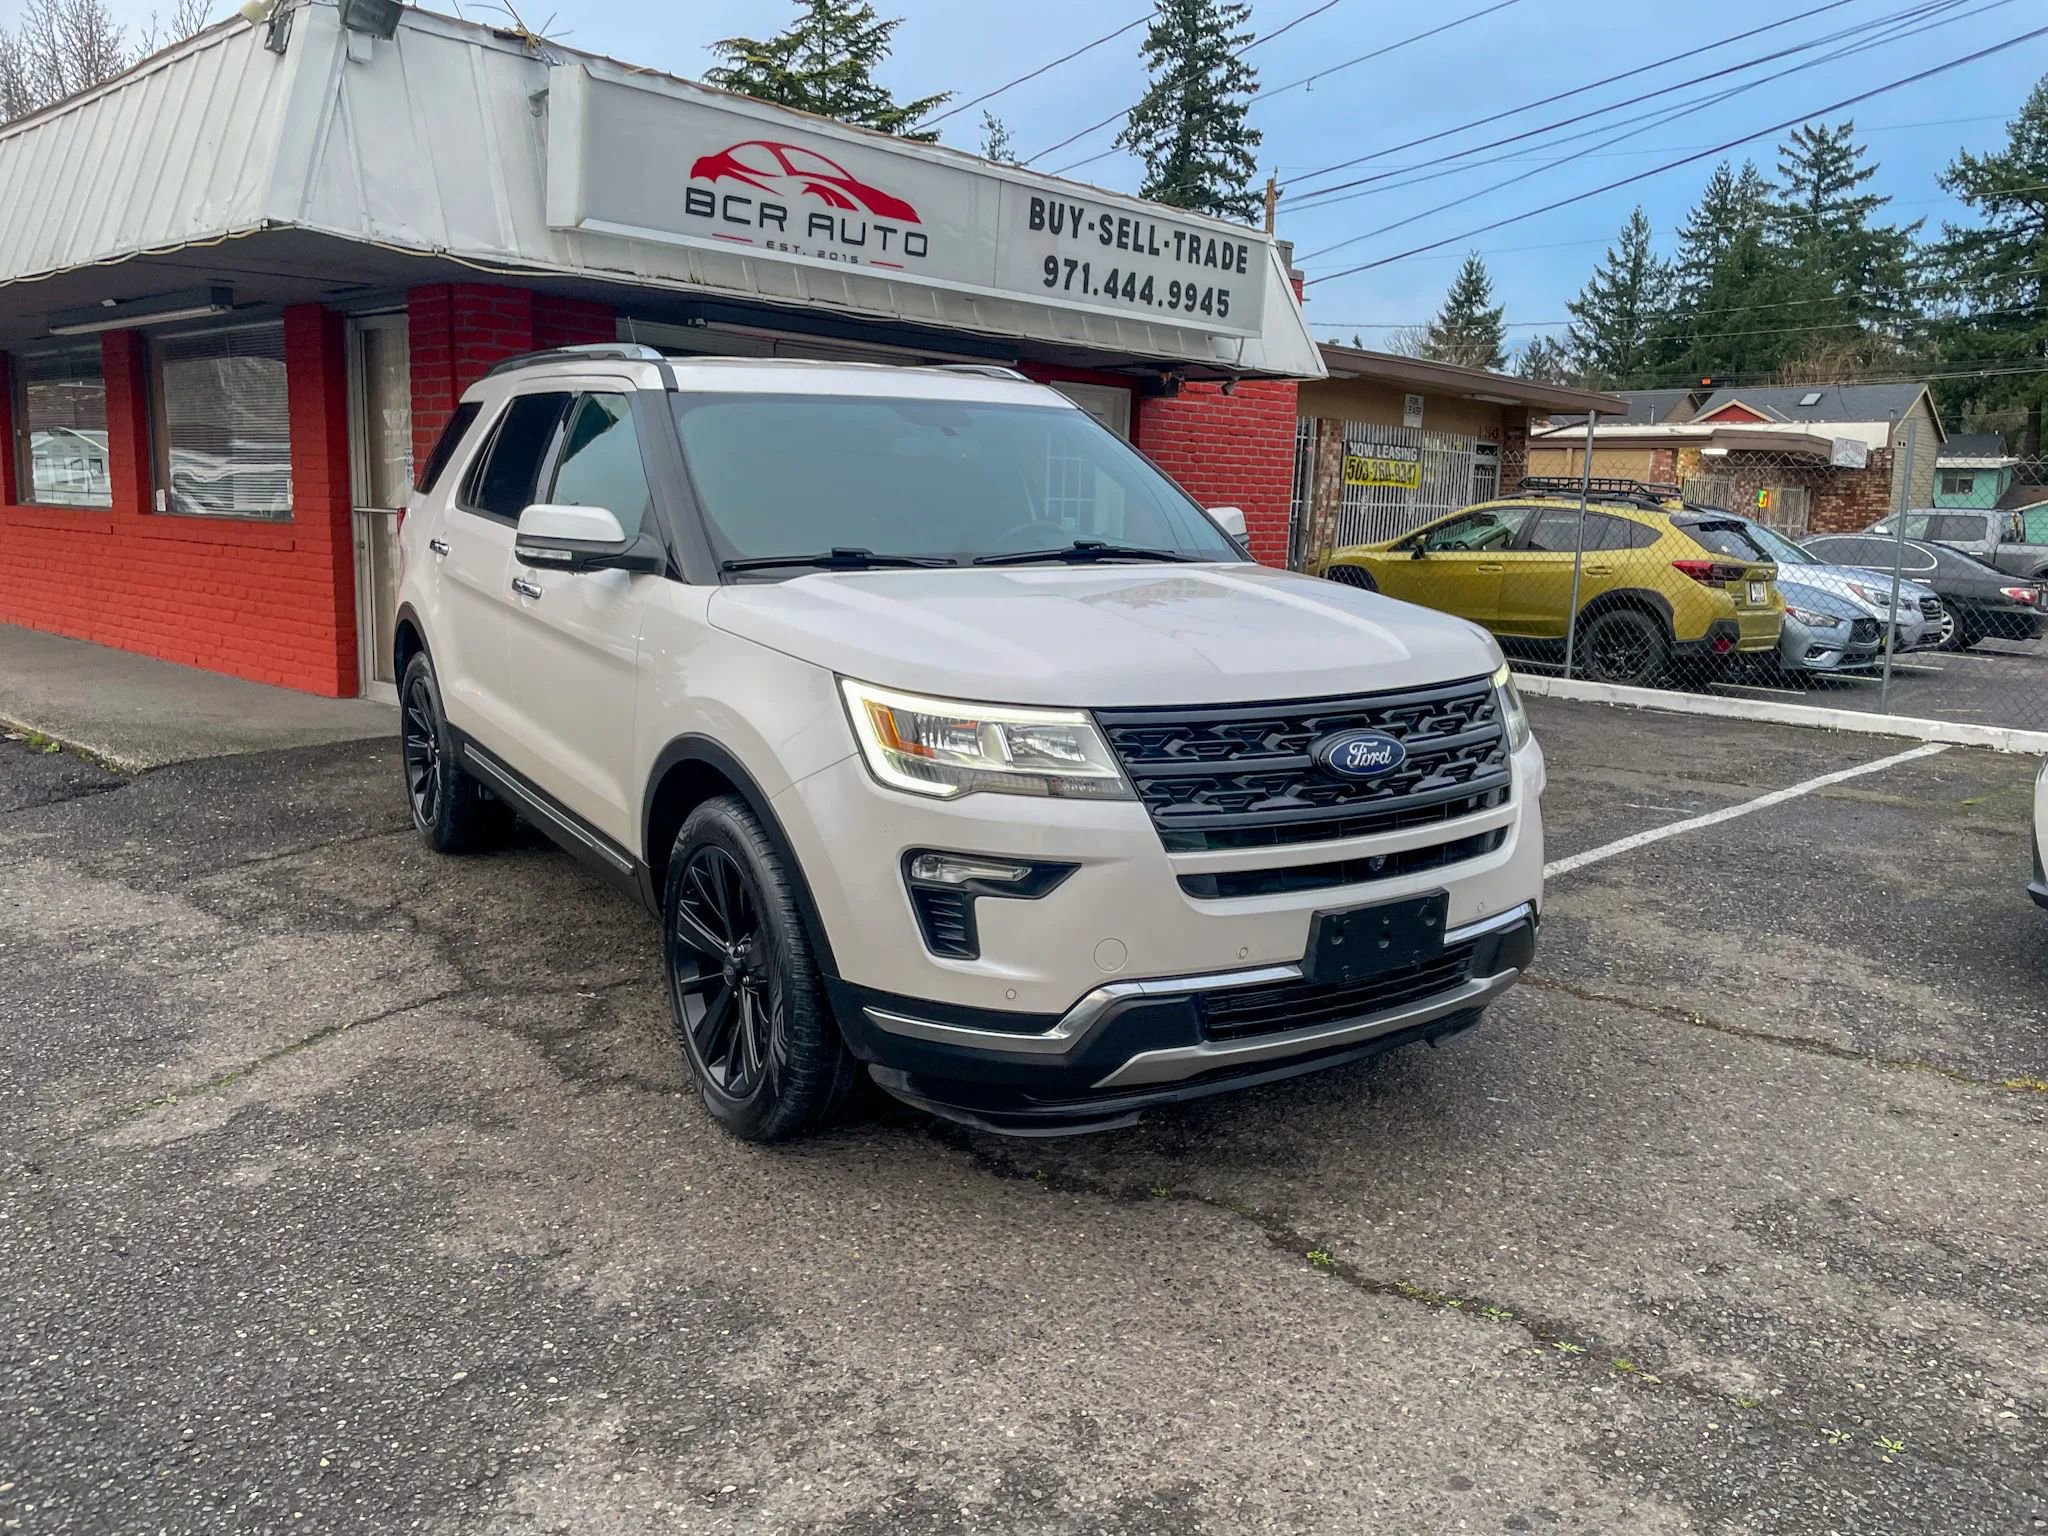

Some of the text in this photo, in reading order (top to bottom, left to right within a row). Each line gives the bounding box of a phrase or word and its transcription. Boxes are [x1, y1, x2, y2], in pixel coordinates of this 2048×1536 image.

[685, 187, 928, 258] BCR AUTO
[766, 240, 859, 264] EST. 2015
[1043, 255, 1230, 318] 971.444.9945
[1349, 441, 1418, 461] NOW LEASING
[1346, 741, 1392, 768] Ford
